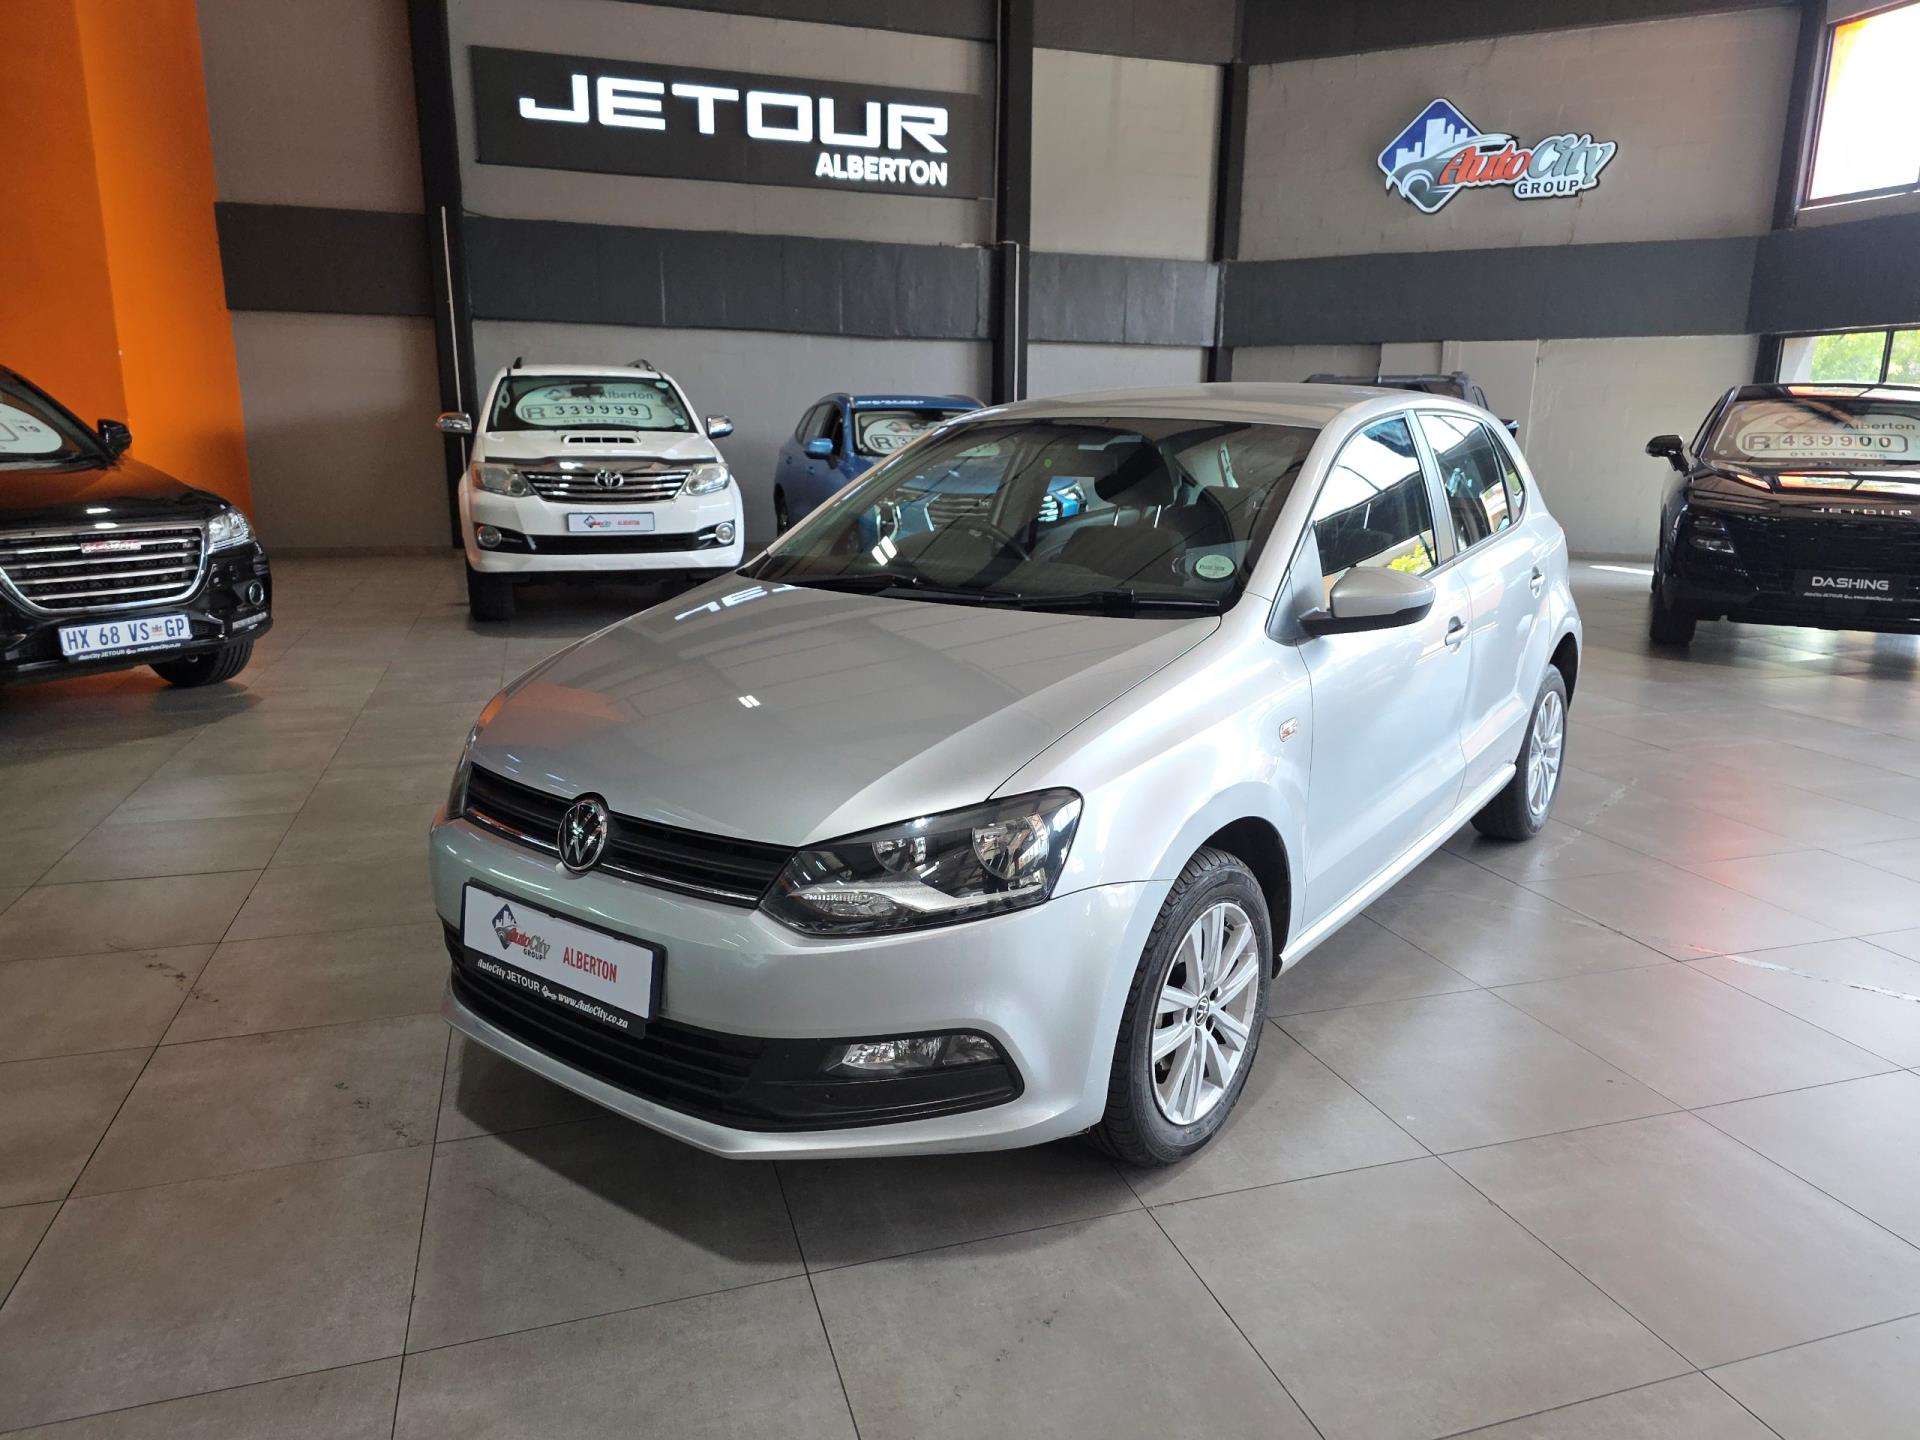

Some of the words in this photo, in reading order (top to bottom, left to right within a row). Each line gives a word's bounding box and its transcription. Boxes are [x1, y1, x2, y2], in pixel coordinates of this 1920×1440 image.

[518, 73, 949, 154] JETOUR
[814, 151, 948, 187] ALBERTON
[1438, 136, 1613, 185] AutoCity
[1517, 180, 1580, 196] GROUP
[1782, 434, 1892, 449] 439900
[1842, 422, 1916, 431] Alberton
[1811, 576, 1889, 591] DASHING
[65, 628, 91, 651] HX
[98, 625, 121, 646] 68
[128, 621, 151, 643] VS
[164, 617, 185, 638] GP
[522, 948, 544, 961] GROUP
[562, 946, 618, 984] ALBERTON
[477, 958, 506, 980] AutoCity
[506, 969, 541, 993] JETOUR
